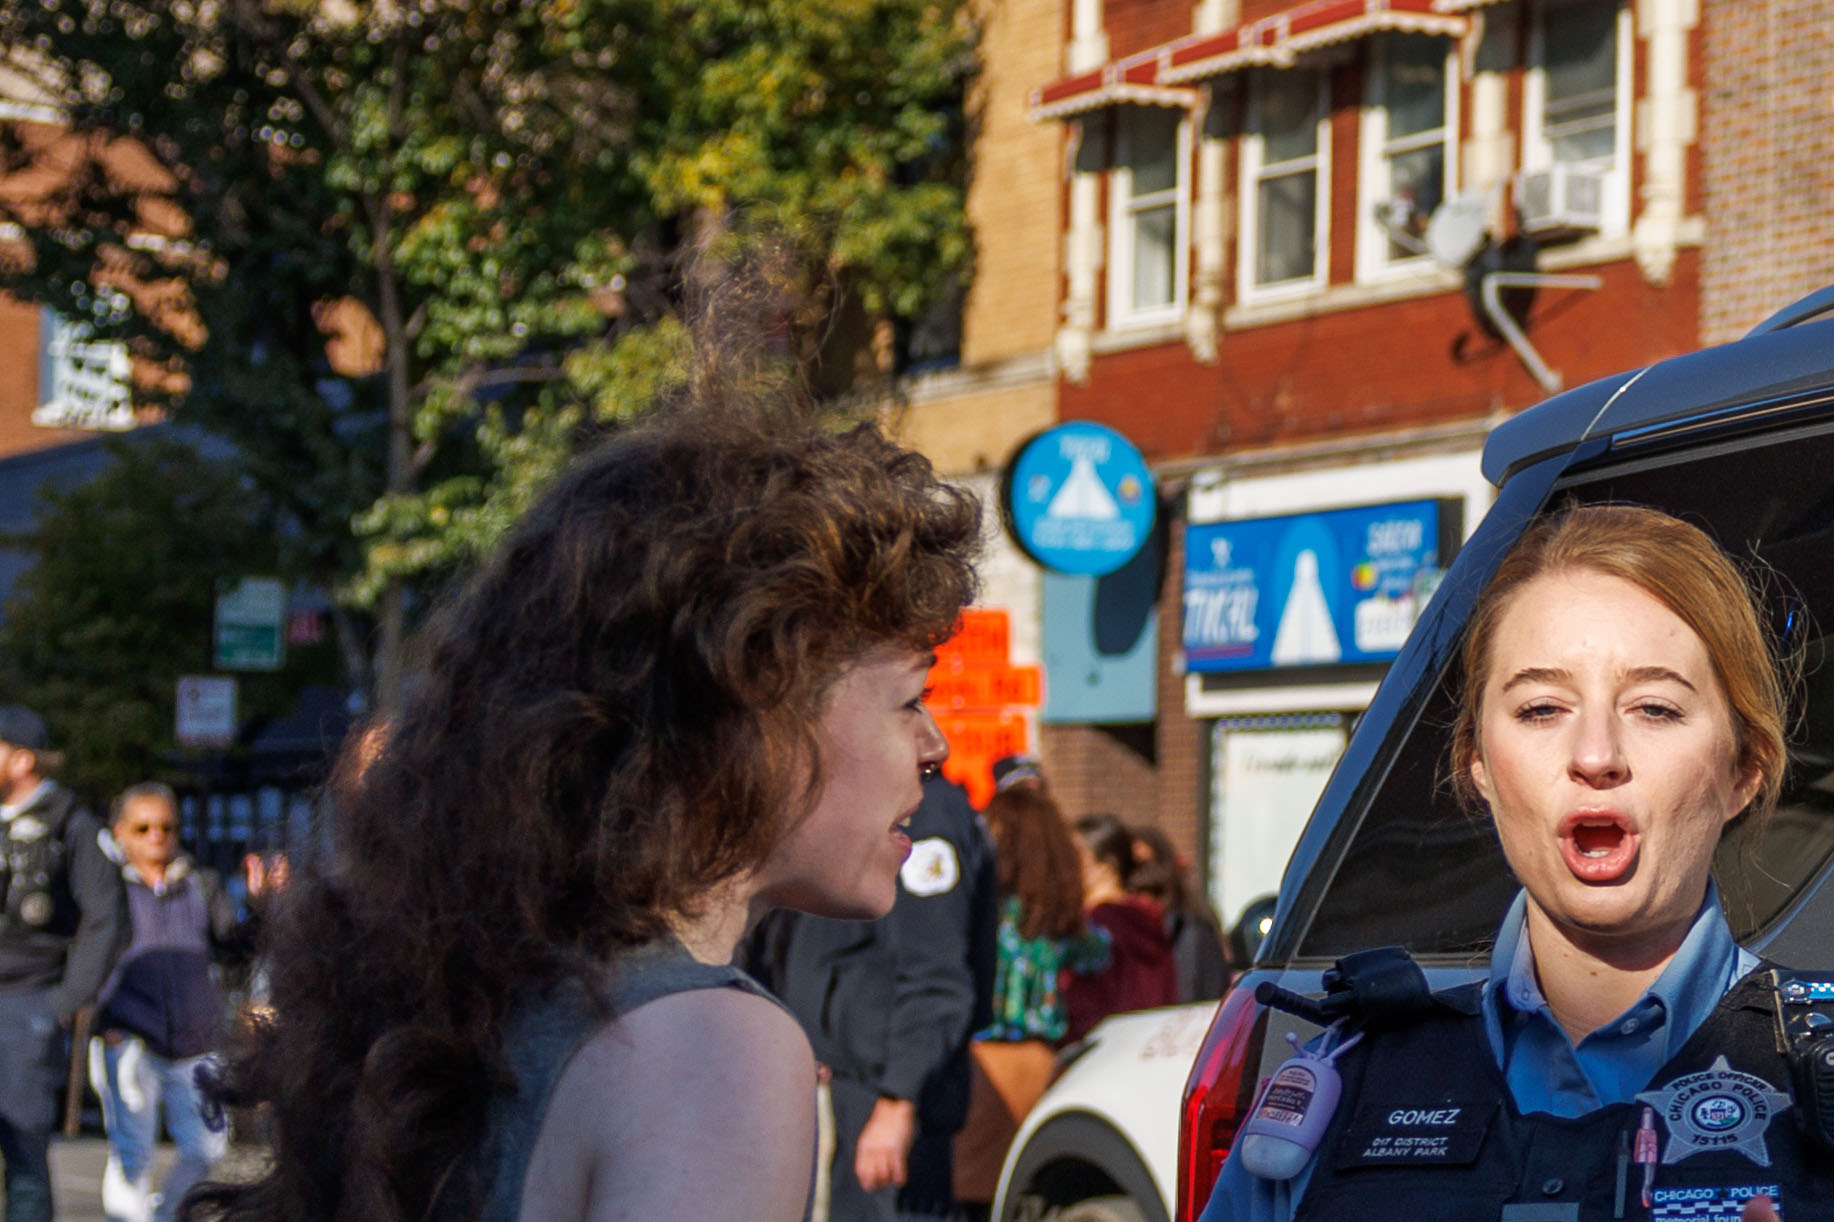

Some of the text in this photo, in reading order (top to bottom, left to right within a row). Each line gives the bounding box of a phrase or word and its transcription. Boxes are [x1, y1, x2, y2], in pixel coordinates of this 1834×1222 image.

[1671, 1071, 1768, 1091] POLICE OFFICER
[1669, 1081, 1768, 1122] CHICAGO POLICE
[1388, 1108, 1462, 1126] GOMEZ
[1394, 1136, 1448, 1147] DISTRICT
[1362, 1146, 1449, 1158] ALBANY PARK
[1654, 1185, 1779, 1202] CHICAGO POLICE
